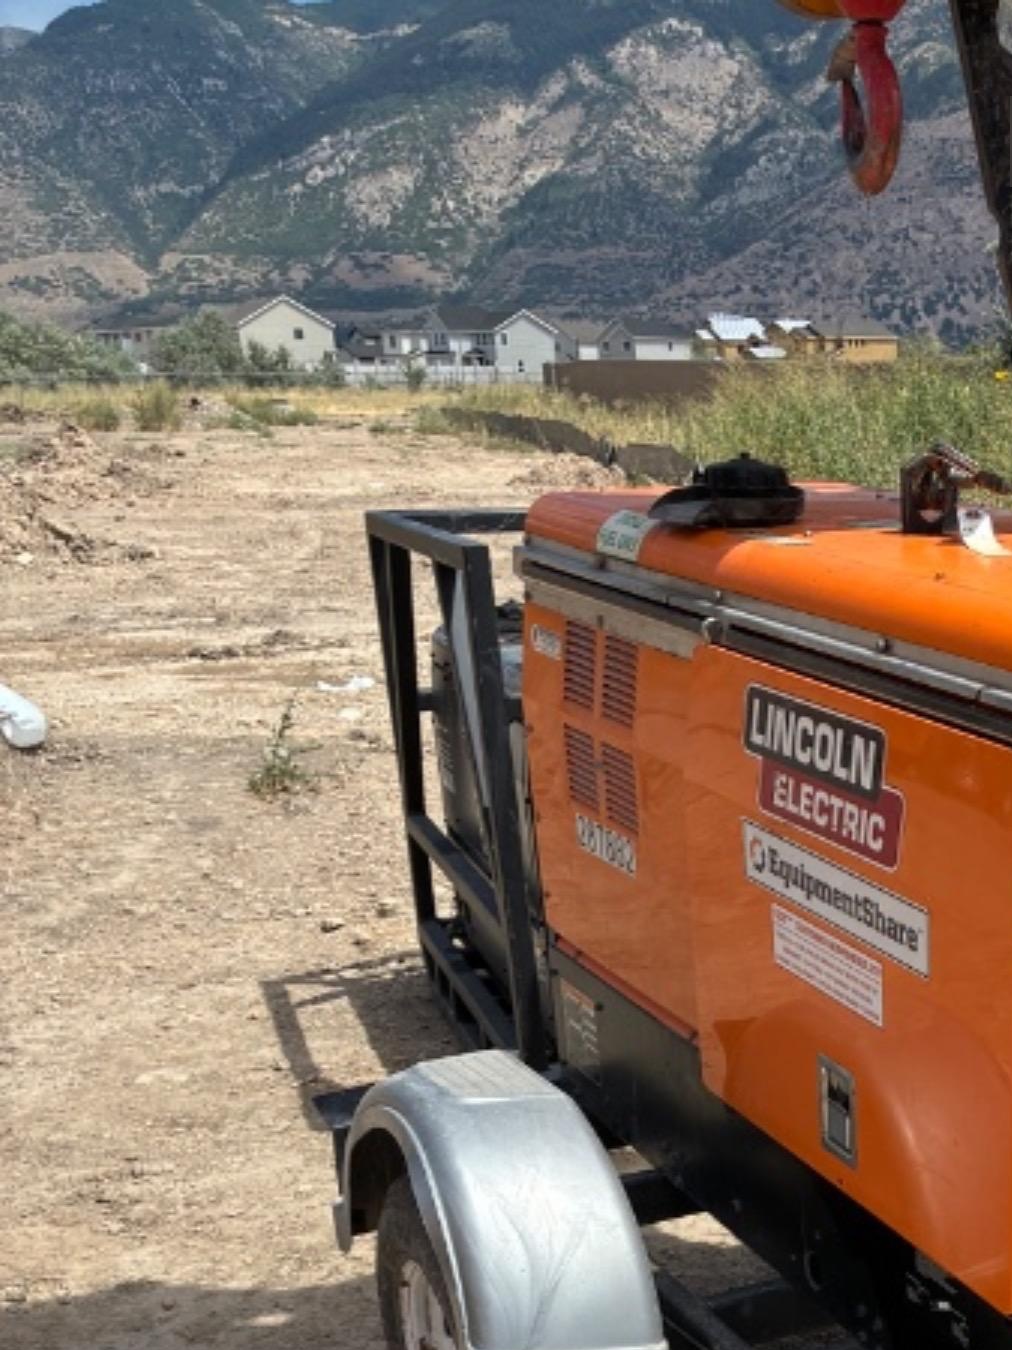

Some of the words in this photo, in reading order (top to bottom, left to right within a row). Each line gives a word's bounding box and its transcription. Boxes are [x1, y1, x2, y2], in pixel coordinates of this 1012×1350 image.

[750, 698, 877, 790] LINCOLN
[773, 771, 886, 853] ELECTRIC
[768, 847, 919, 952] EquipmentShare
